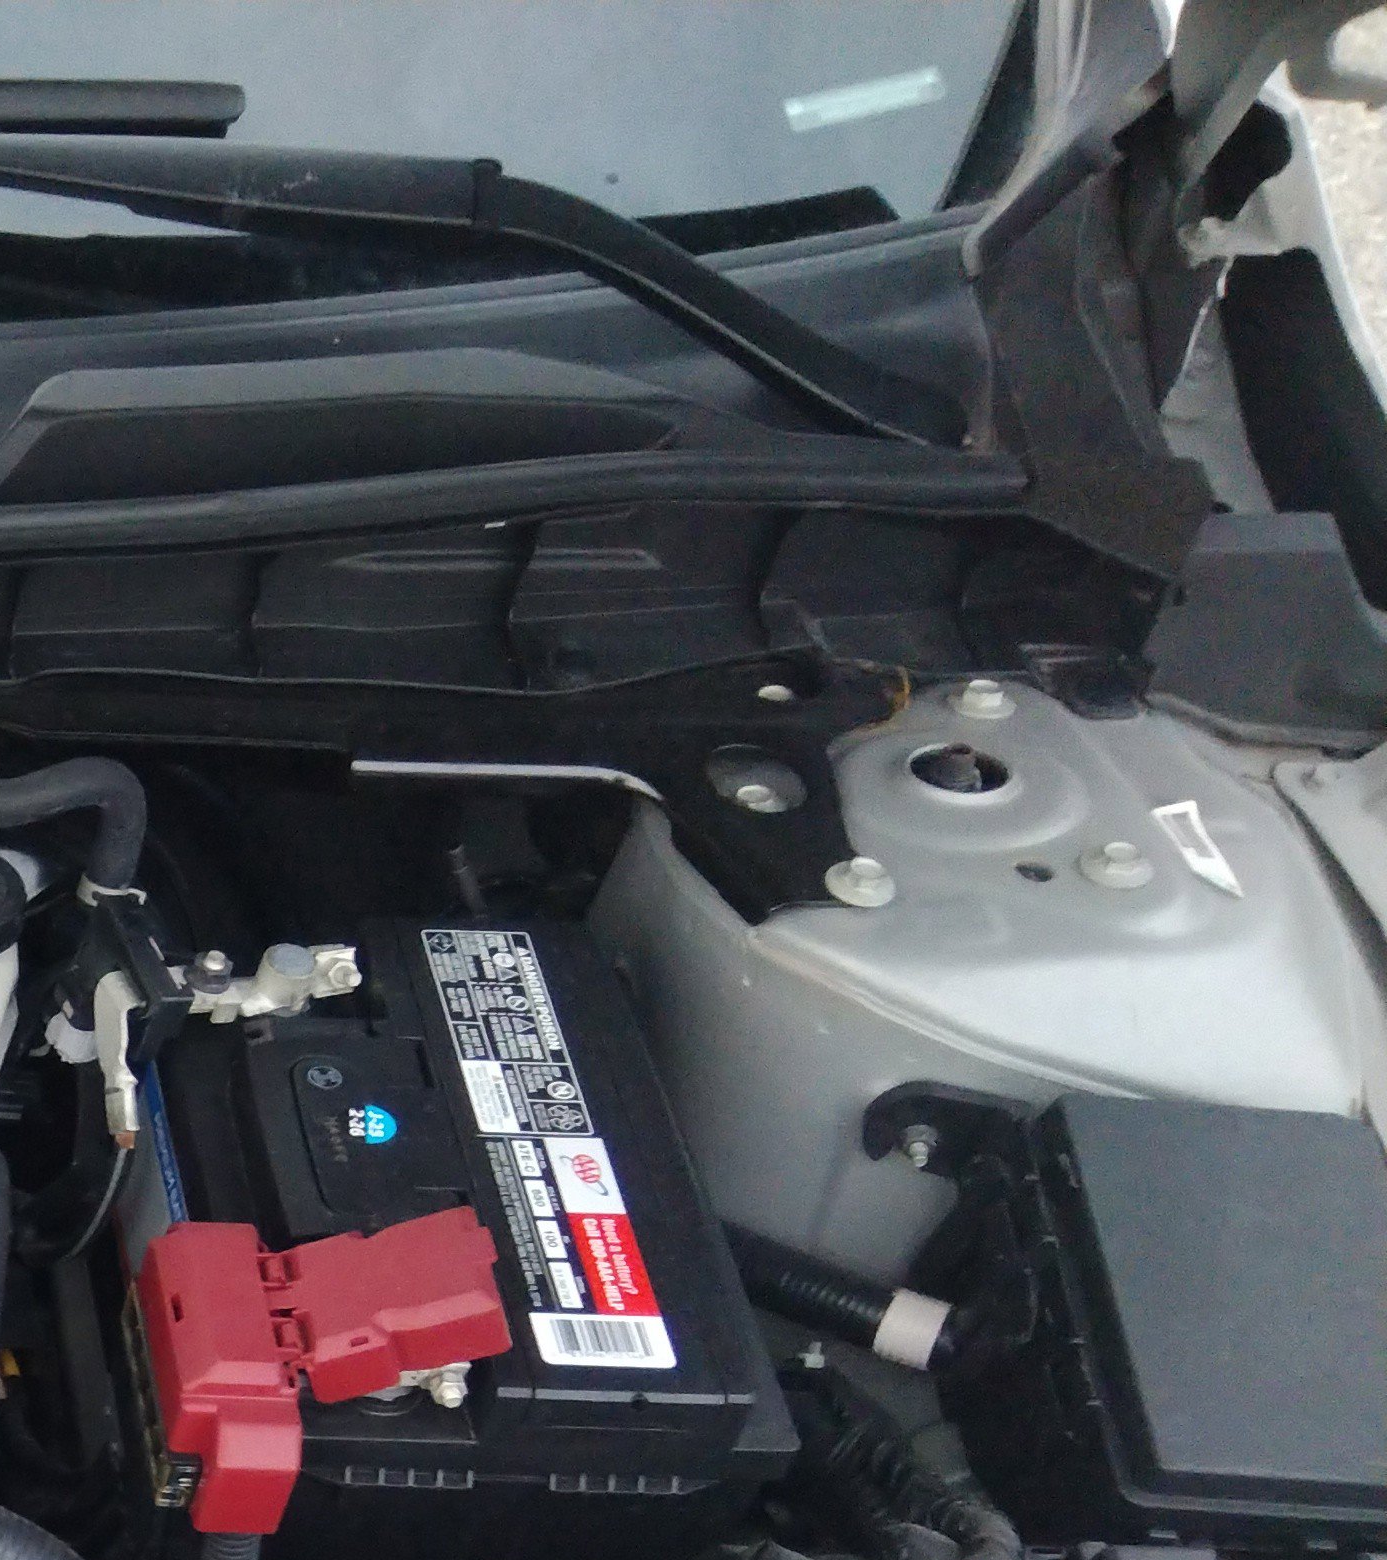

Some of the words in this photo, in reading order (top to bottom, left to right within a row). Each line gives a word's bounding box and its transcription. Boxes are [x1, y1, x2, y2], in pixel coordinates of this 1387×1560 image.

[581, 1218, 601, 1236] Call
[600, 1218, 620, 1241] Need
[610, 1254, 639, 1294] battery?
